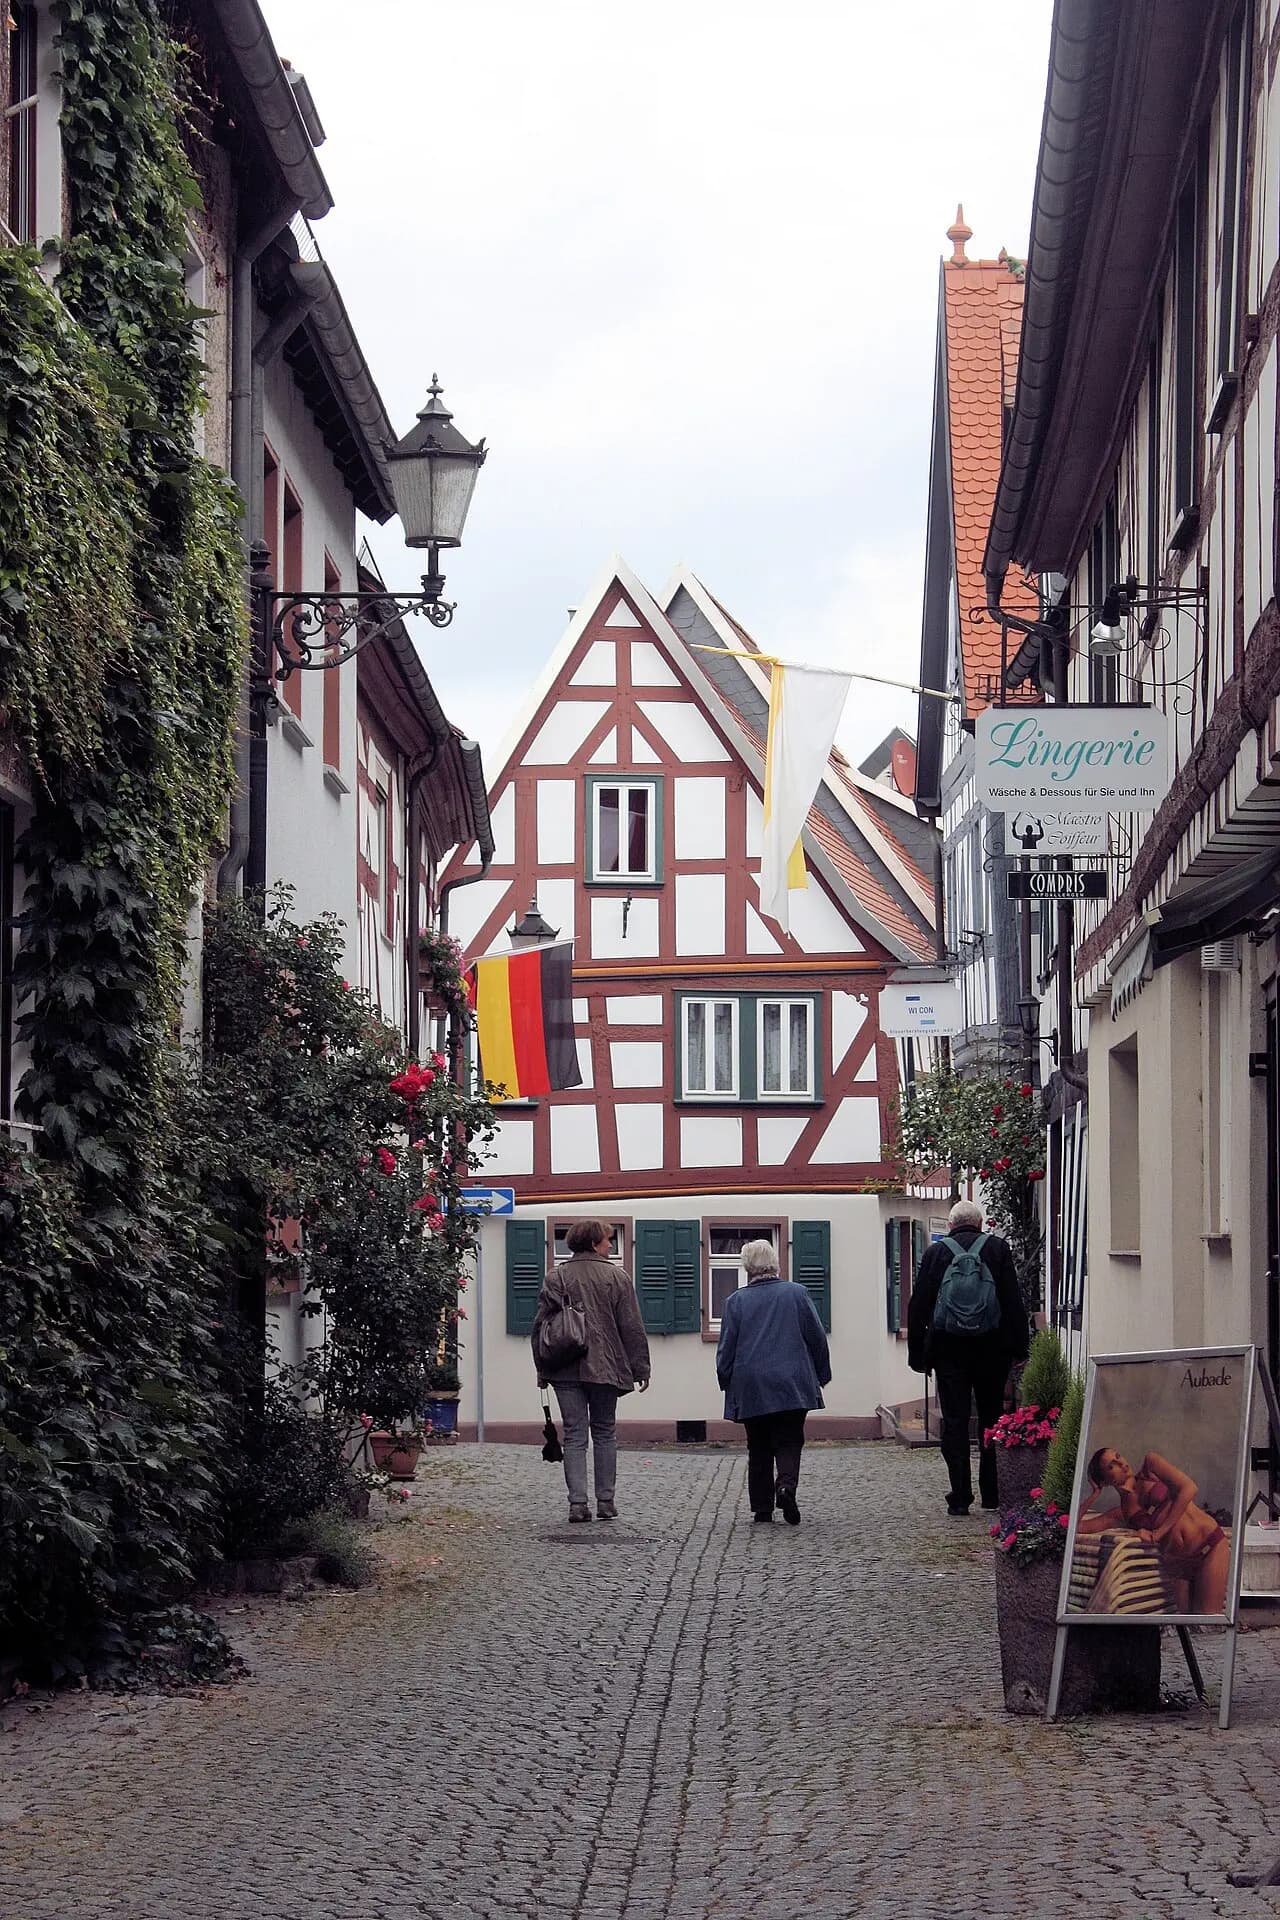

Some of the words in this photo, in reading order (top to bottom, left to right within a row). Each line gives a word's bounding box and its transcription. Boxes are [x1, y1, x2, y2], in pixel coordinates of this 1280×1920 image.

[988, 717, 1155, 781] Lingerie
[989, 787, 1027, 797] Wäsche
[1029, 787, 1037, 797] &
[1040, 787, 1082, 797] Dessous
[1084, 787, 1098, 797] für
[1100, 787, 1116, 797] Sie
[1118, 787, 1137, 797] und
[1140, 787, 1155, 797] Ihn
[1043, 811, 1103, 826] Maestro
[1048, 831, 1101, 849] Coiffeur
[1030, 873, 1085, 893] COMPRIS
[919, 1006, 934, 1015] CON
[1180, 1366, 1232, 1388] Aubade
